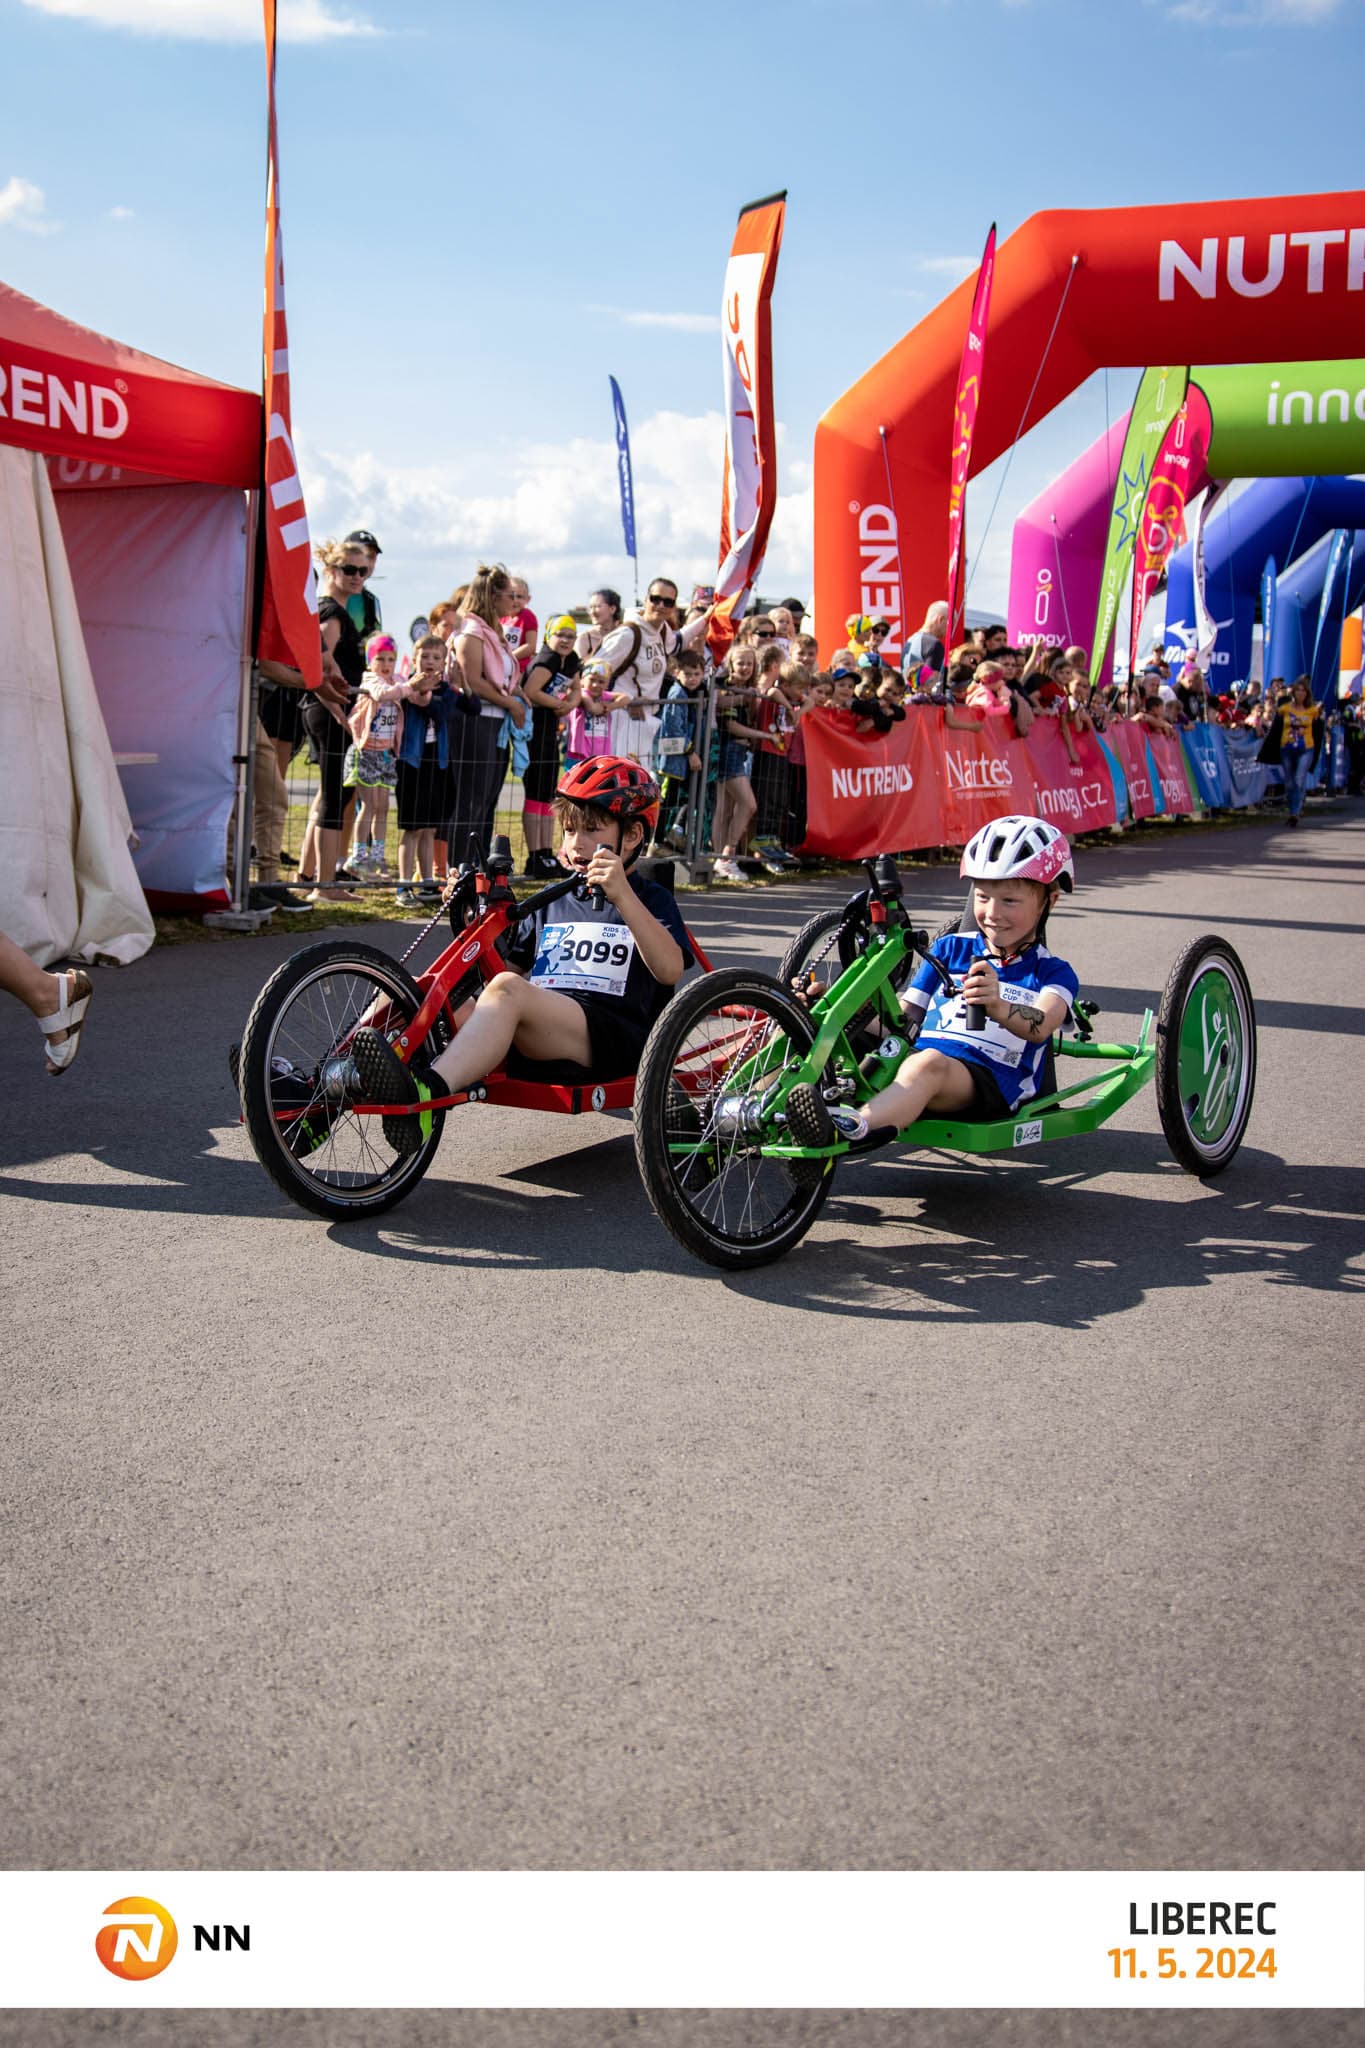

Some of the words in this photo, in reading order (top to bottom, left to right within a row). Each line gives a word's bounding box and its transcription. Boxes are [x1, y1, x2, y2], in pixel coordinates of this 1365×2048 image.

[1158, 228, 1365, 302] NUT
[0, 364, 129, 440] END
[832, 764, 913, 799] NUTREND
[944, 750, 1013, 788] Nartes
[603, 926, 620, 934] KIDS
[559, 940, 629, 967] 3099
[1002, 993, 1018, 1001] CUP
[1003, 987, 1022, 996] KIDS
